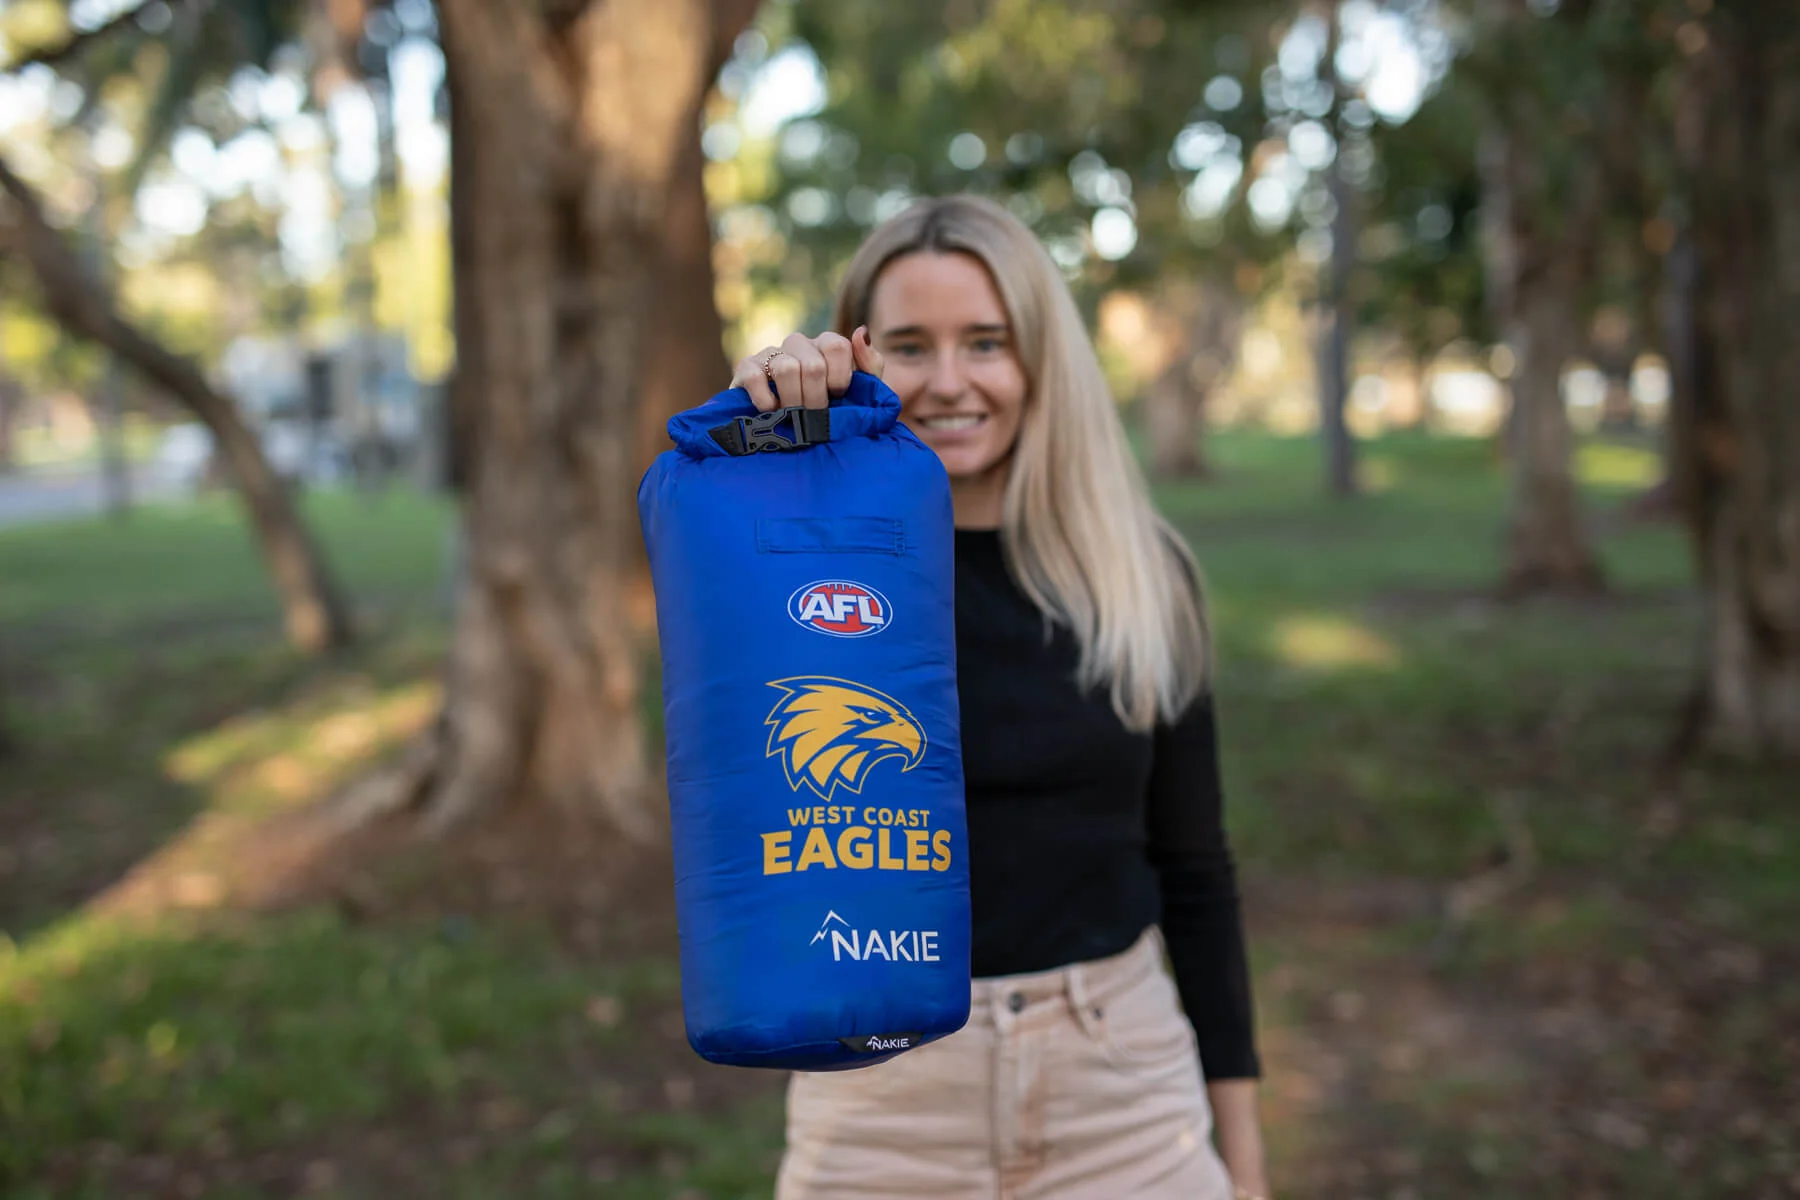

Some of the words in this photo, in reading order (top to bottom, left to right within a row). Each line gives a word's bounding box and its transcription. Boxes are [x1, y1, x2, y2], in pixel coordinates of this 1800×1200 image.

[800, 593, 885, 625] AFL
[787, 805, 855, 826] WEST
[863, 807, 930, 828] COAST
[760, 826, 952, 876] EAGLES
[831, 929, 940, 962] NAKIE
[872, 1038, 910, 1050] NAKIE
